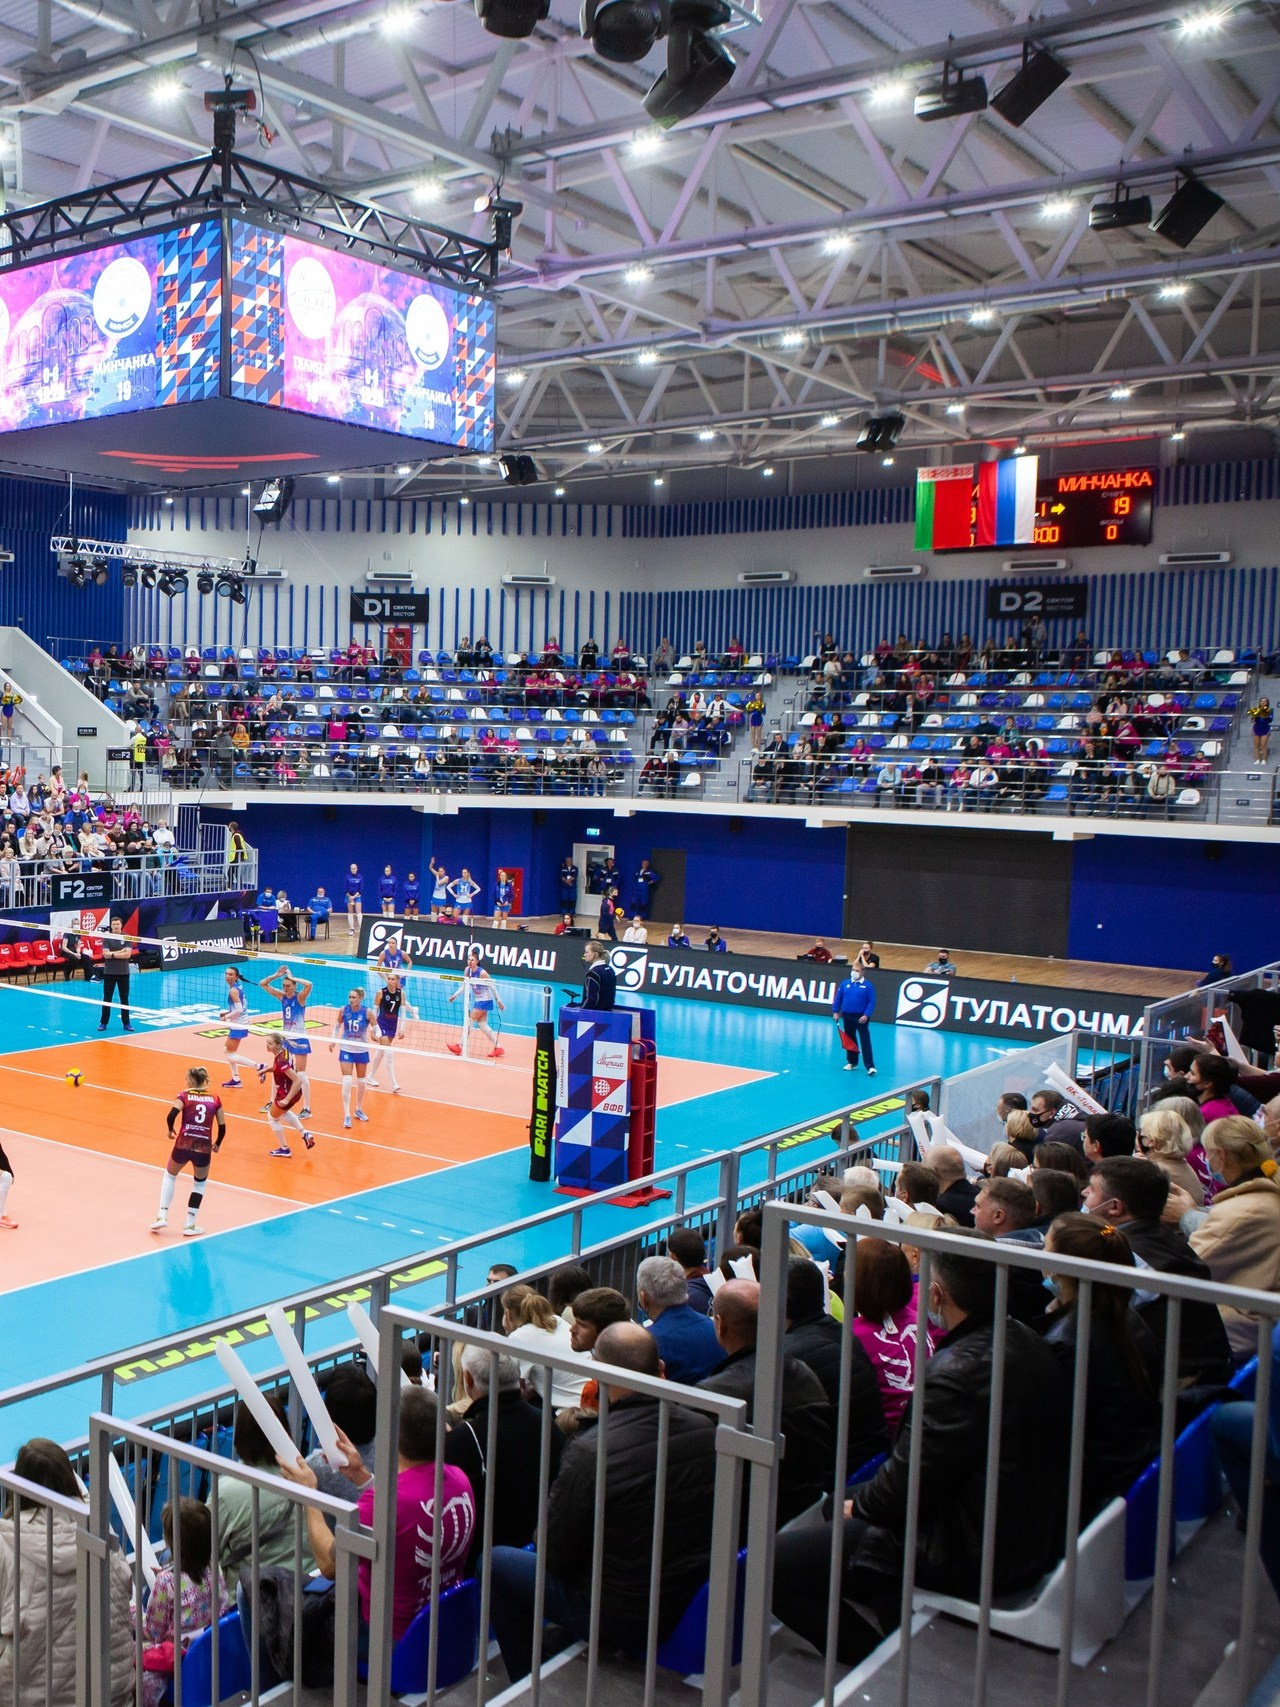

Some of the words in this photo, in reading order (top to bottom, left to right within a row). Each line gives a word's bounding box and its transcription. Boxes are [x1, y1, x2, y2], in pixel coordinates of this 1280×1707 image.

[93, 352, 156, 376] МИНЧАНКА
[116, 380, 131, 401] 19
[1058, 471, 1152, 493] МИНЧАНКА
[1114, 497, 1130, 514] 19
[1106, 525, 1117, 540] 0
[364, 598, 390, 616] D1
[1000, 591, 1043, 611] D2
[60, 880, 86, 899] F2
[404, 935, 557, 972] ТУЛАТОЧМАШ
[648, 962, 836, 1005] ТУЛАТОЧМАШ
[285, 1006, 291, 1019] 9
[389, 1000, 396, 1013] 7
[347, 1019, 360, 1032] 15
[536, 1049, 549, 1112] MATCH
[1066, 1085, 1078, 1096] ВК
[194, 1104, 207, 1123] 3
[603, 1102, 624, 1113] ВФВ
[534, 1113, 548, 1158] PARI
